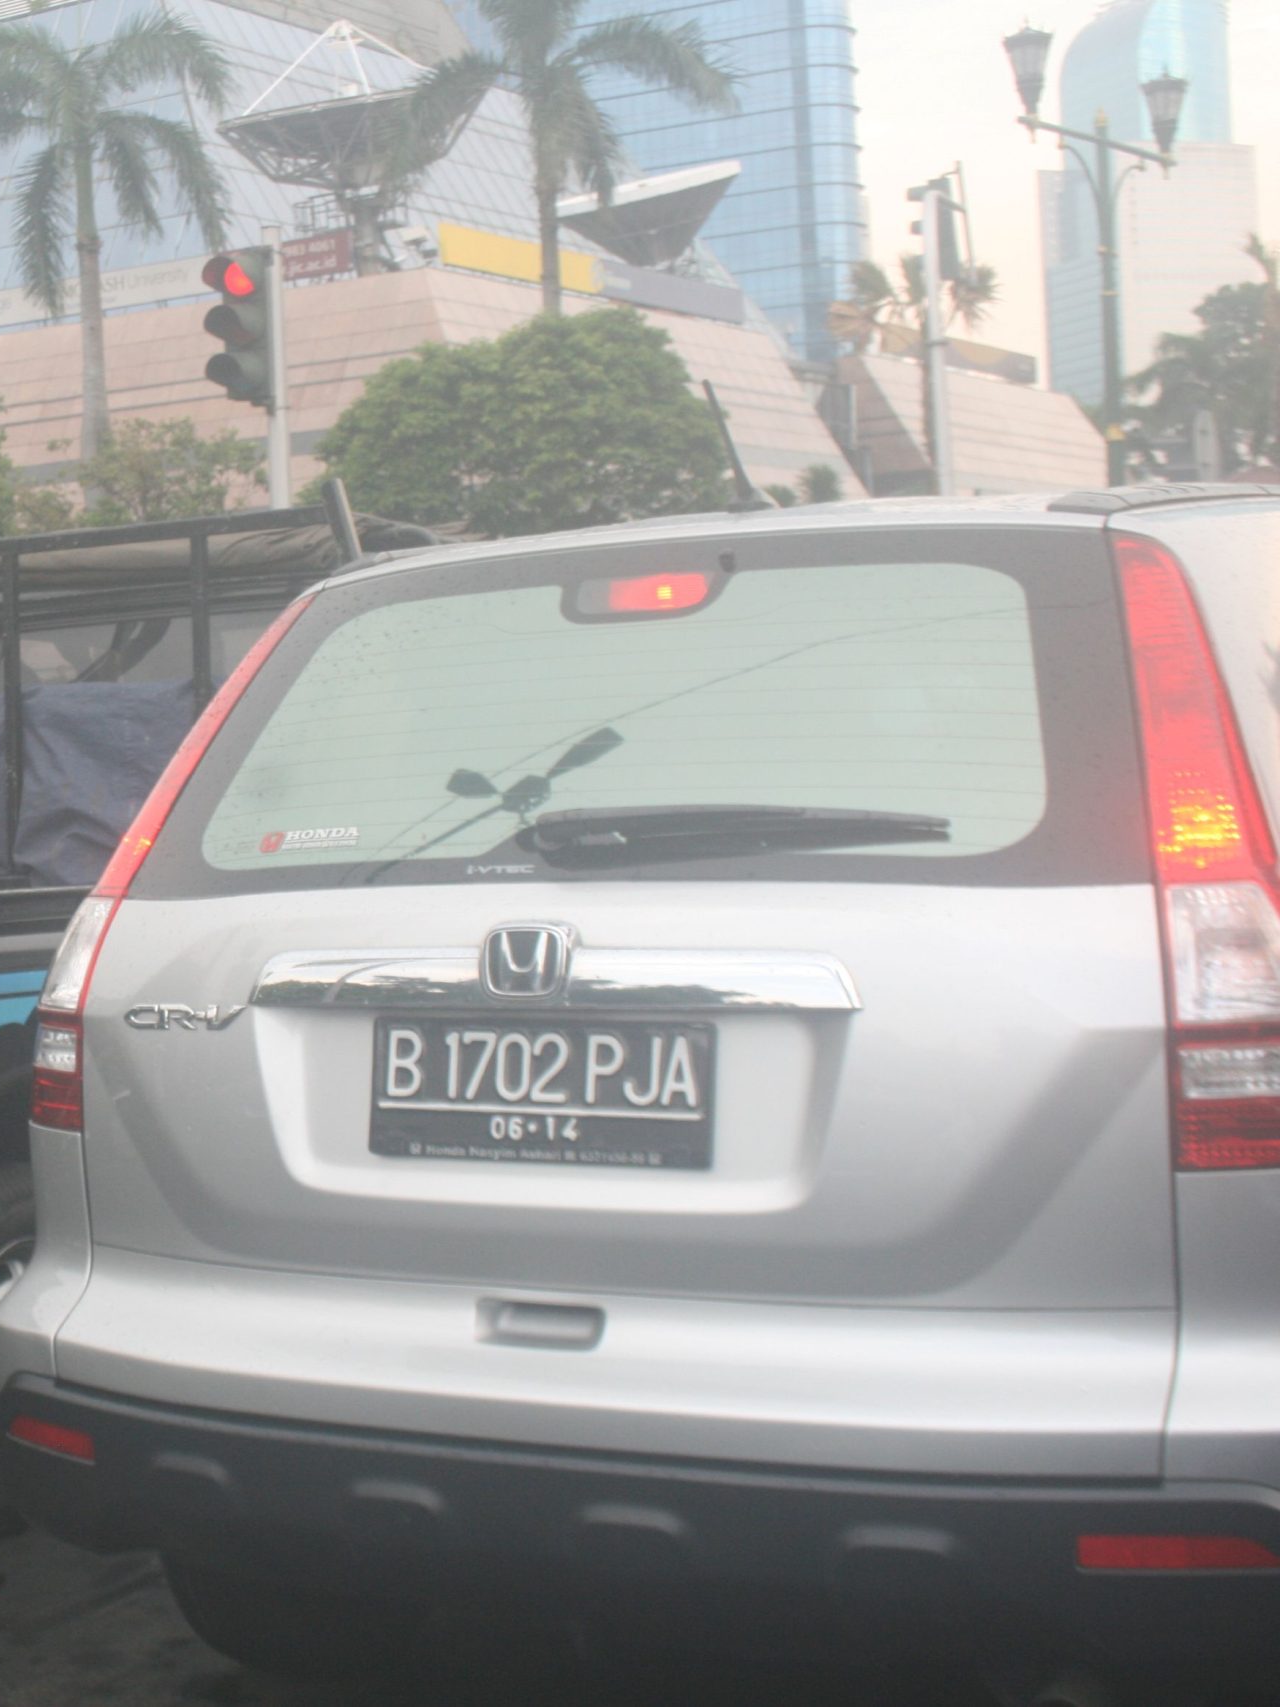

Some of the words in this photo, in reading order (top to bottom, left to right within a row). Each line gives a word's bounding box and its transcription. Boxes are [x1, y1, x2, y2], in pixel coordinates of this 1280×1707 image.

[286, 826, 360, 841] HONDA
[123, 1003, 248, 1030] CR-V
[386, 1029, 423, 1098] B
[445, 1031, 569, 1104] 1702
[584, 1034, 698, 1107] PJA
